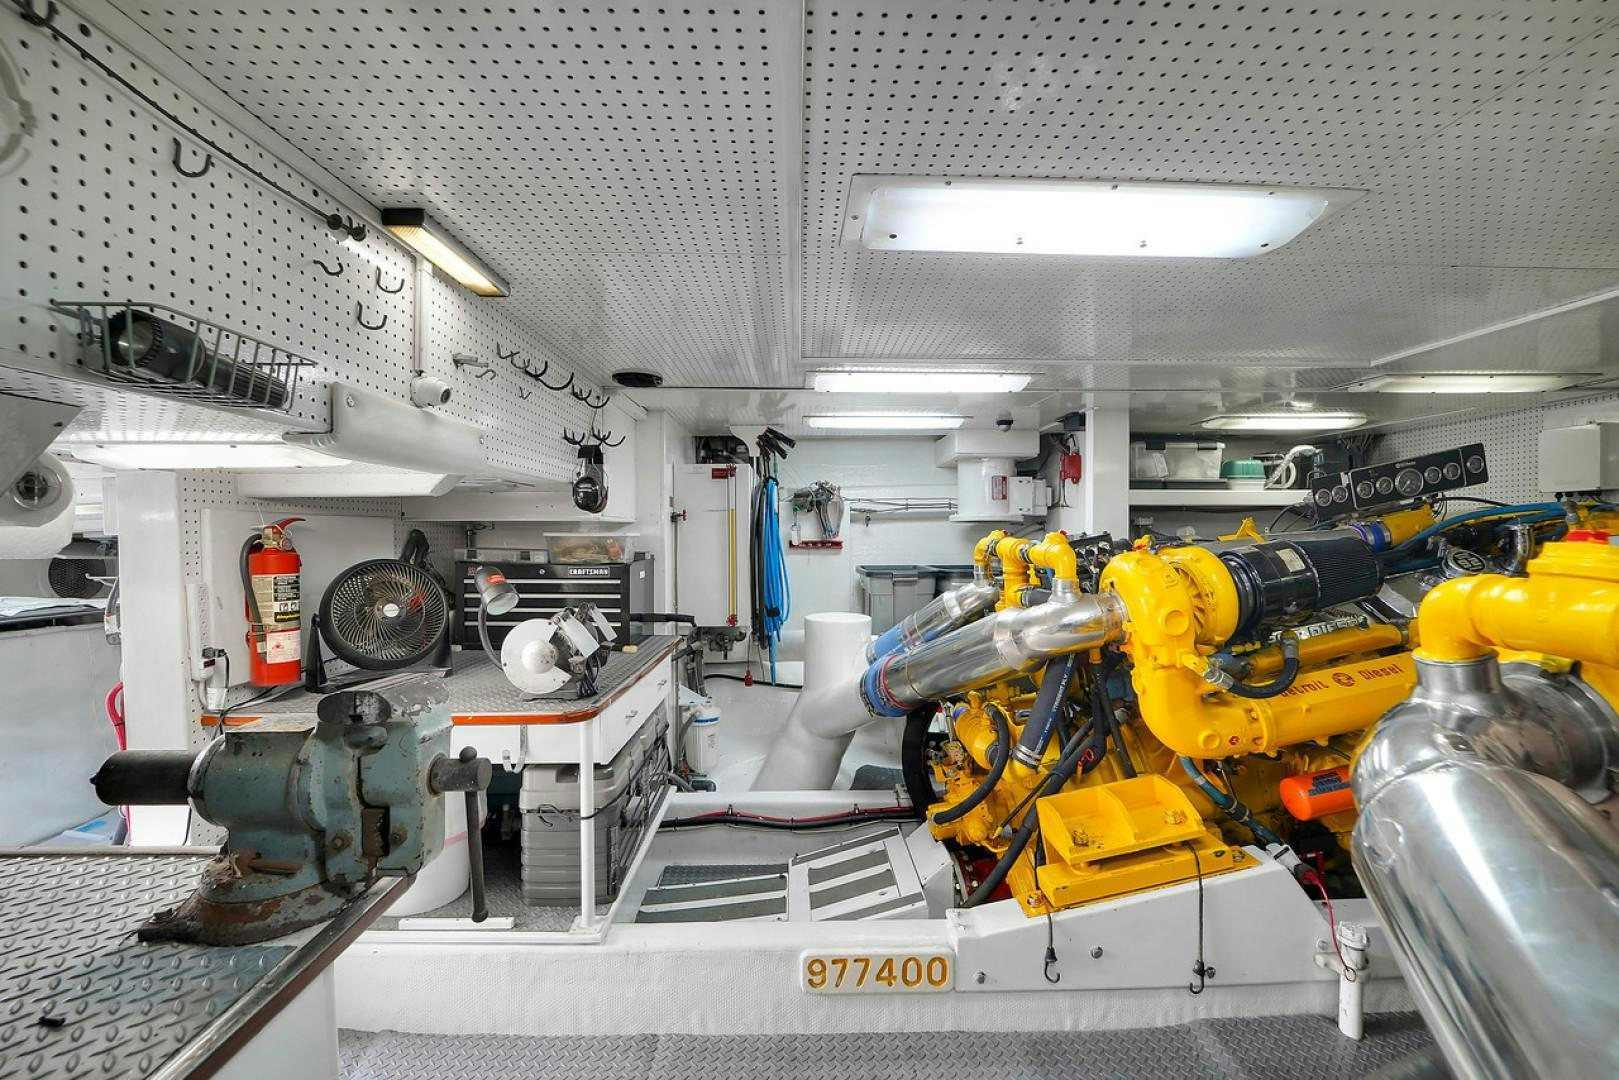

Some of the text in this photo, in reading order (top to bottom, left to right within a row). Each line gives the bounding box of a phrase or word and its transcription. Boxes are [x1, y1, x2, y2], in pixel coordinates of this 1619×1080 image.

[569, 568, 608, 576] CRAFTSMAN
[1358, 664, 1404, 681] Diesel
[807, 956, 948, 989] 977400
